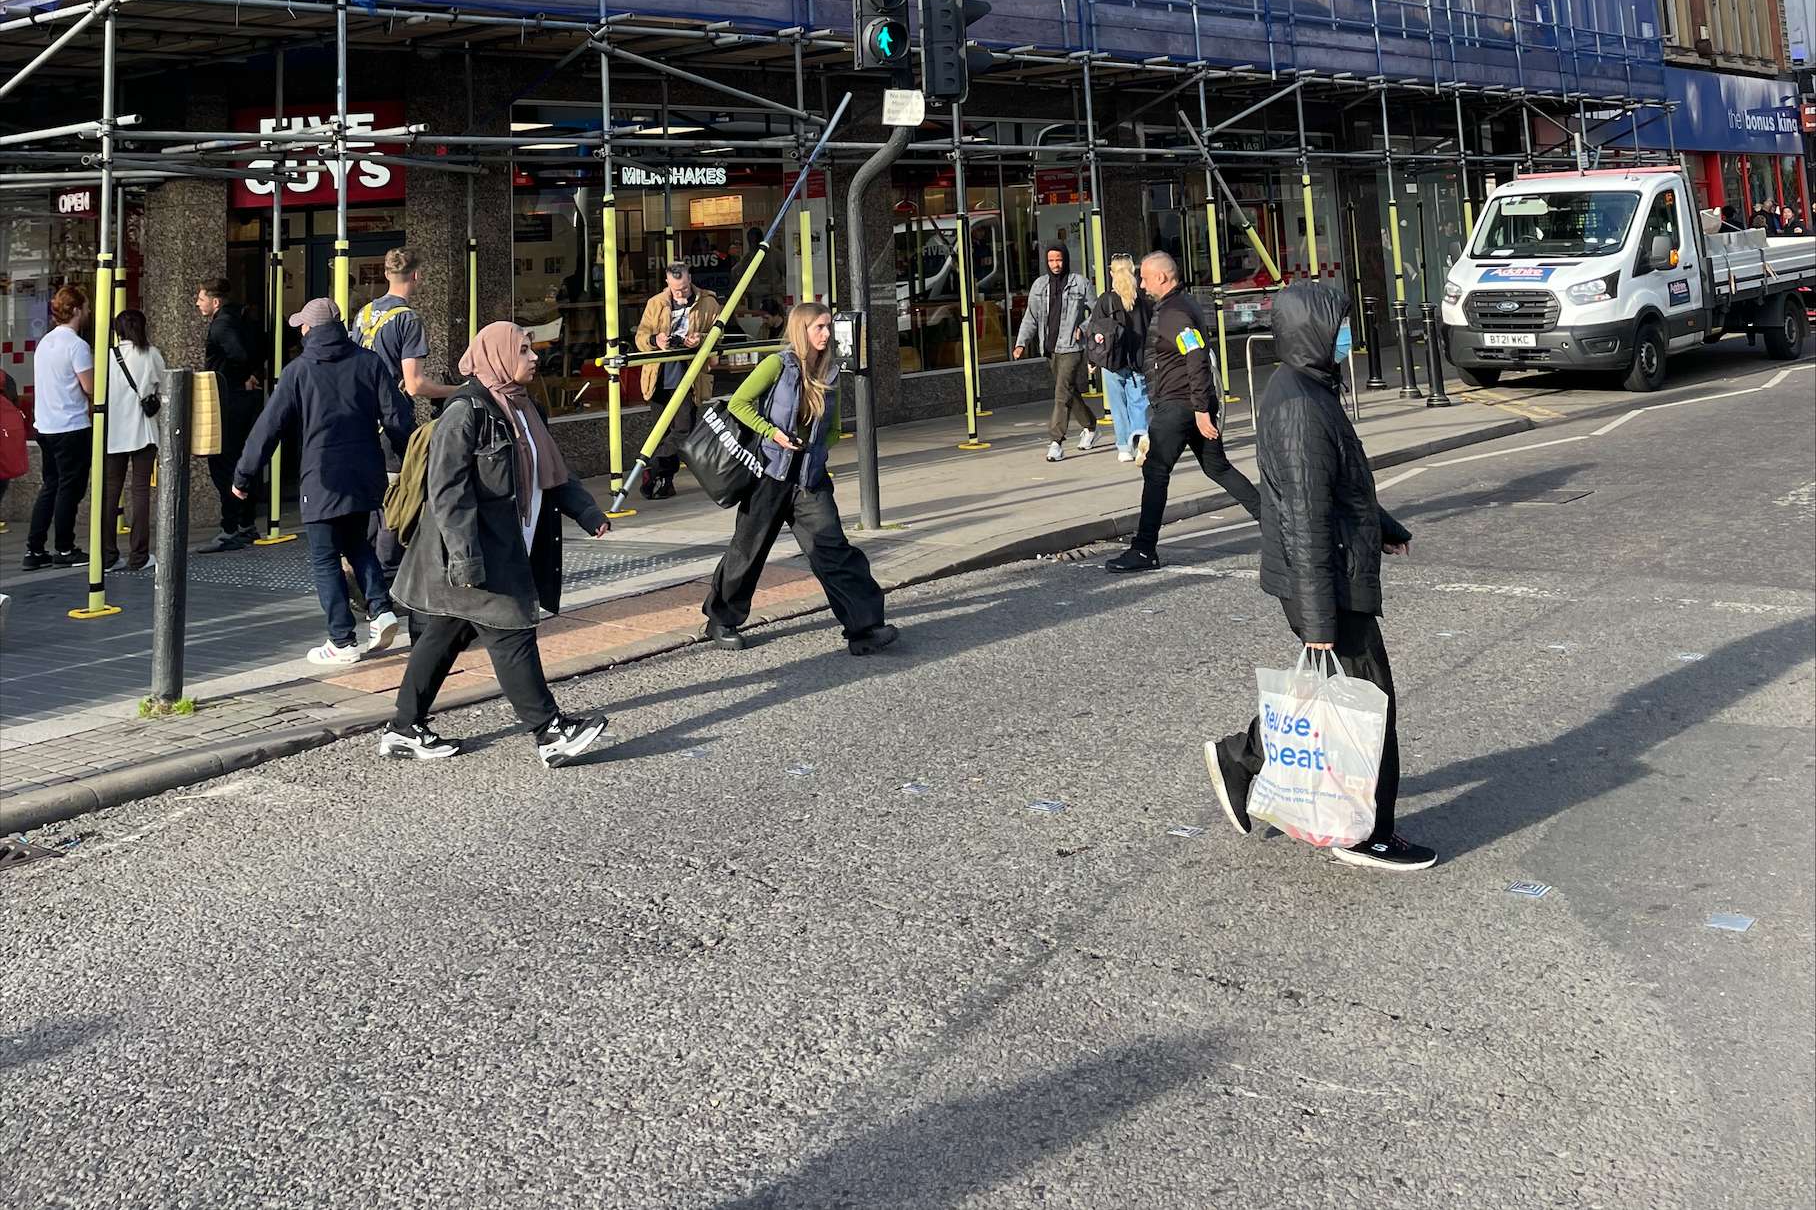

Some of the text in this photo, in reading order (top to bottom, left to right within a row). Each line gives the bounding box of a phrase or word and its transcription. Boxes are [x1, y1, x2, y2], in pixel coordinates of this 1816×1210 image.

[1728, 108, 1799, 136] the bonus king
[622, 167, 727, 185] MILKHAKES
[59, 192, 90, 213] OPEN
[684, 253, 719, 268] GUYS
